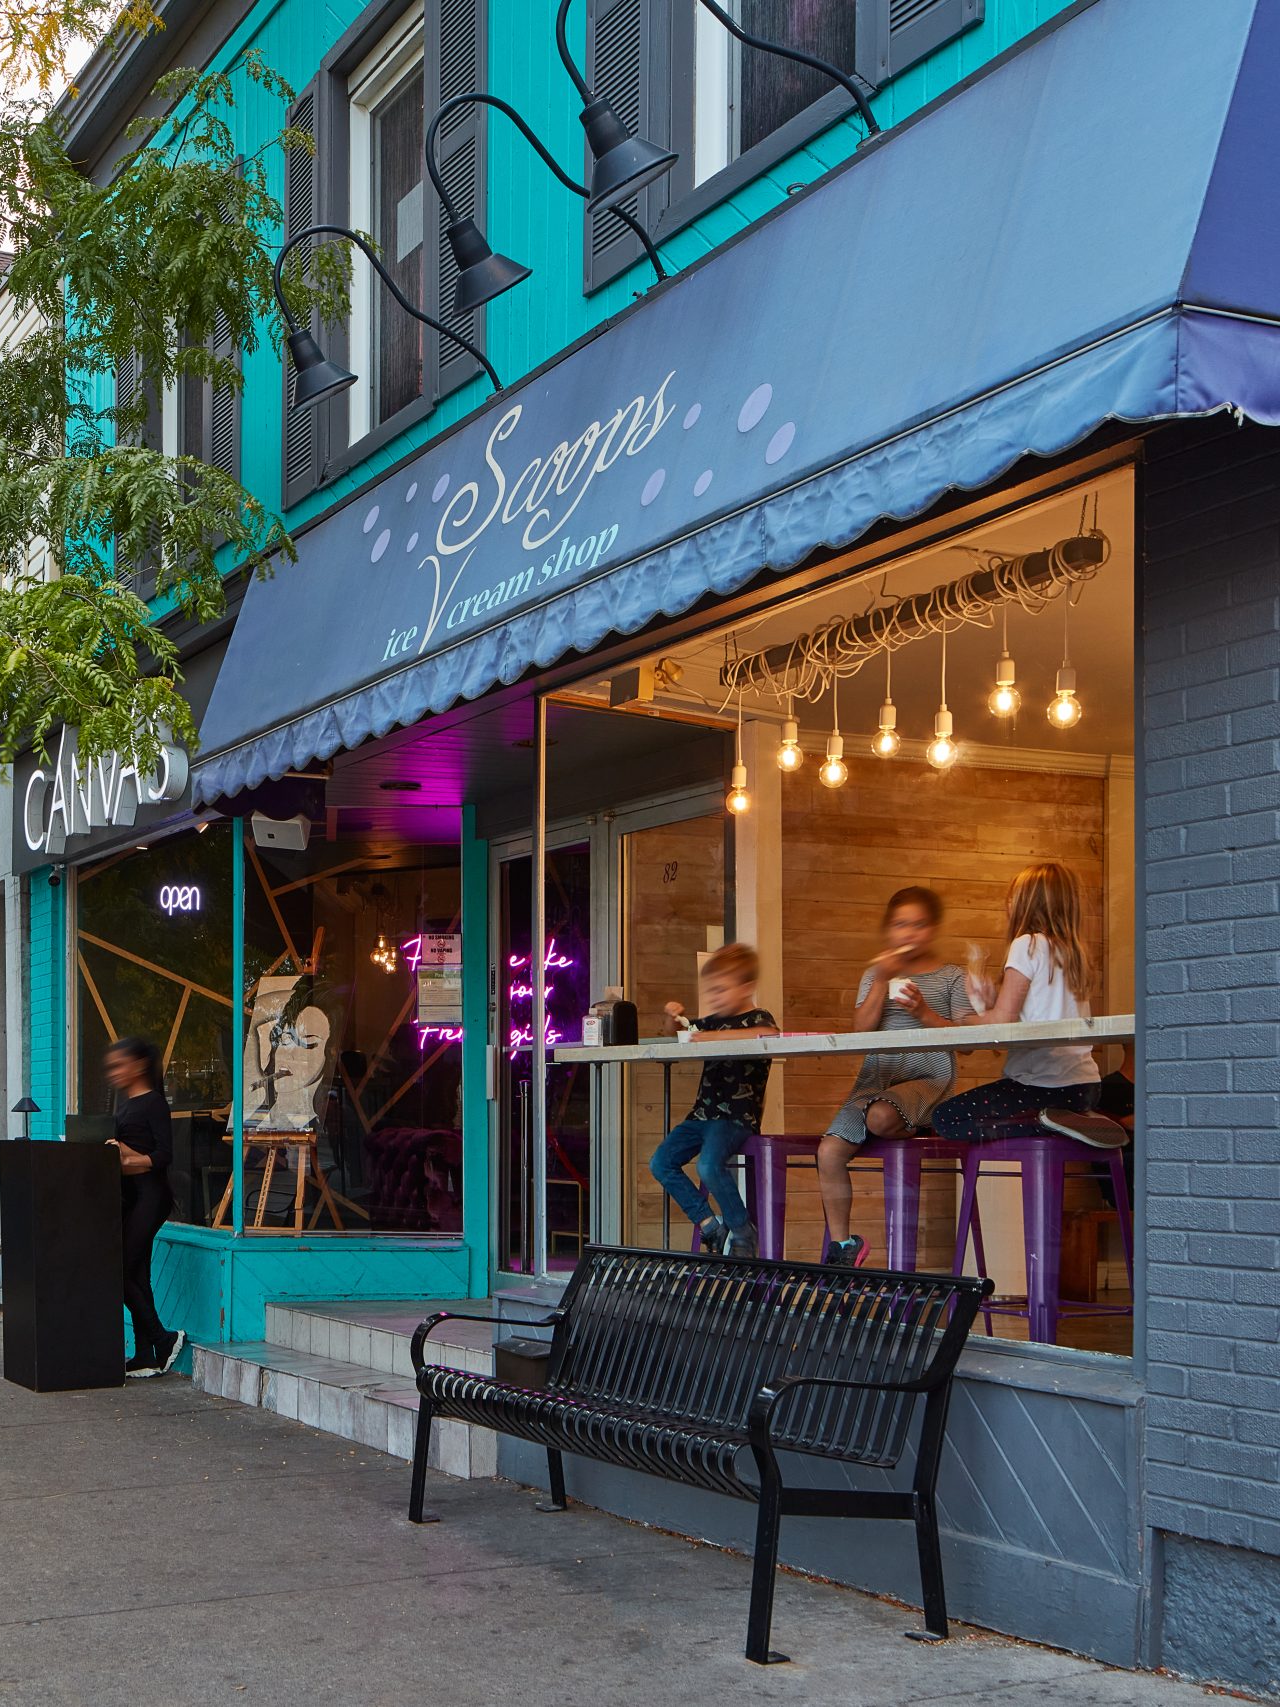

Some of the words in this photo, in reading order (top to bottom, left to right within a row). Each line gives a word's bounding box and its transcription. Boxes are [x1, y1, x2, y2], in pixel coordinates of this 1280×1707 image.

[436, 370, 676, 555] Scoops
[381, 625, 417, 663] ice
[446, 566, 536, 631] cream
[537, 523, 620, 589] shop
[24, 684, 174, 854] CANVAS
[160, 885, 200, 916] open
[663, 860, 679, 884] 82
[509, 1014, 562, 1060] gils
